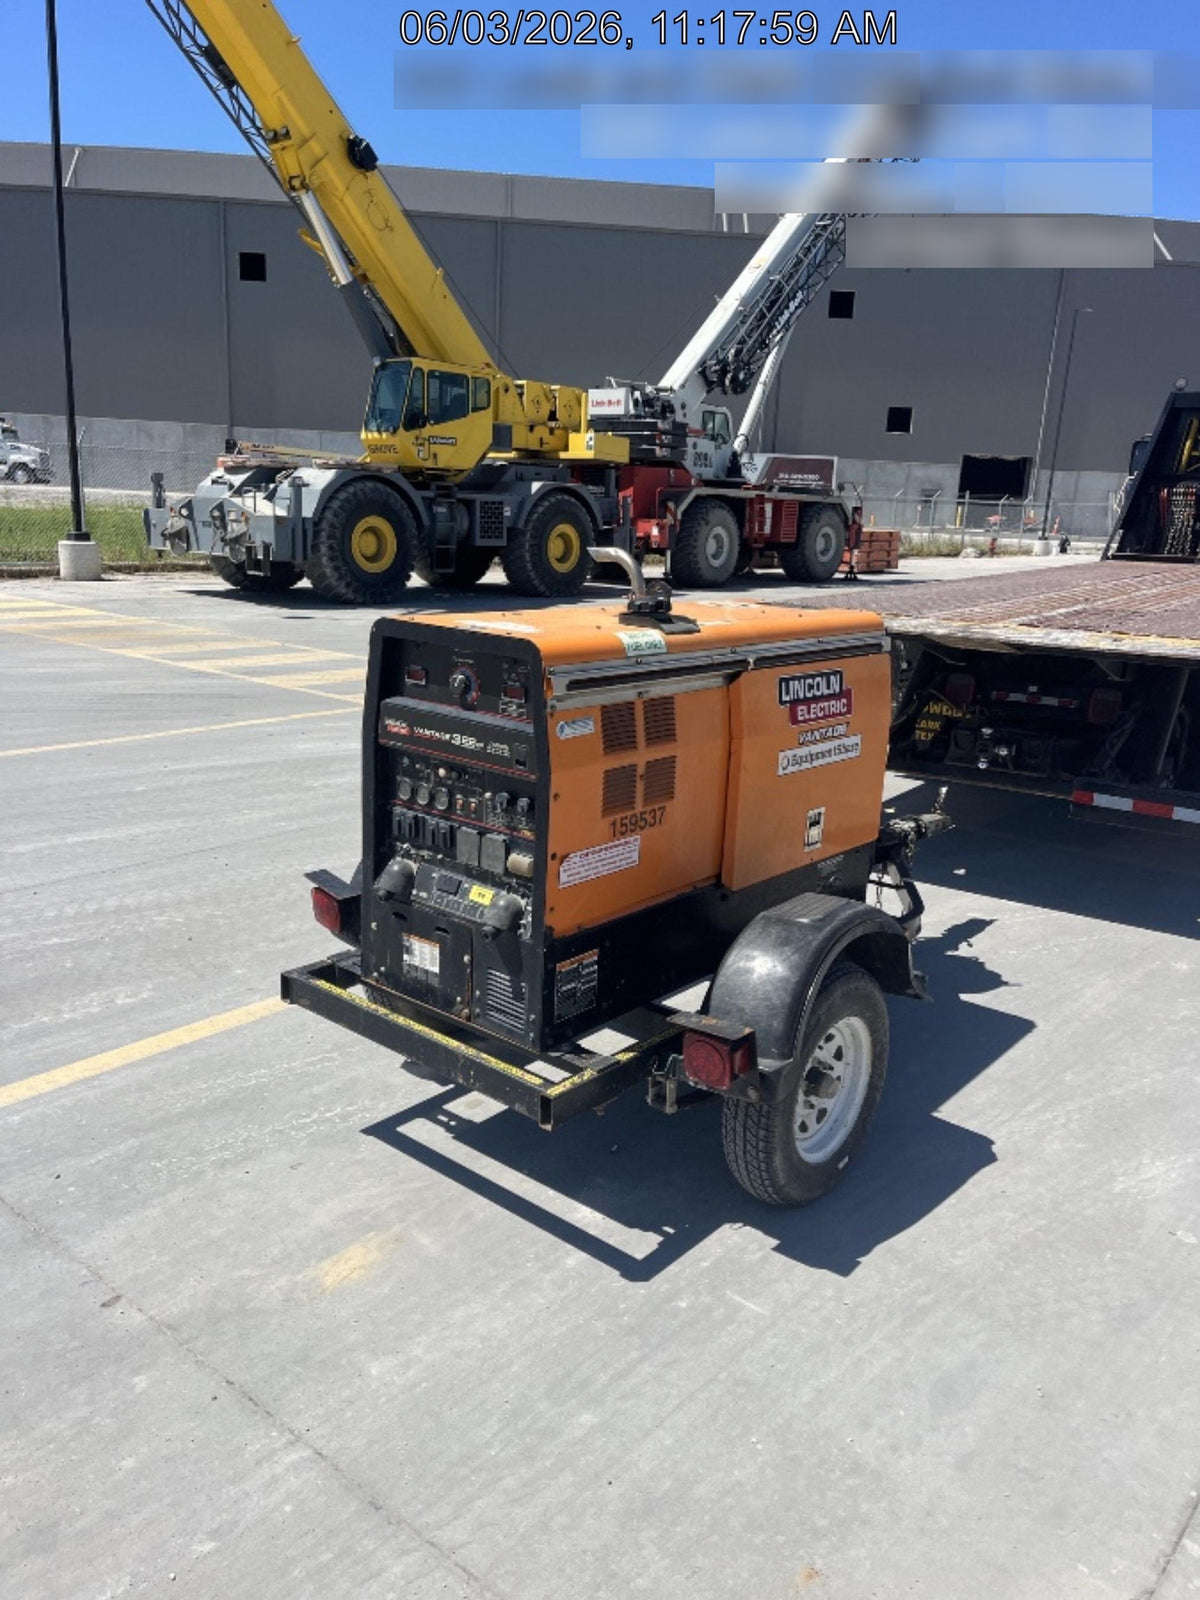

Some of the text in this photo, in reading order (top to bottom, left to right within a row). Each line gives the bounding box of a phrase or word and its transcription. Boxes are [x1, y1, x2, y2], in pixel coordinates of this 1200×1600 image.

[781, 673, 841, 702] LINCOLN
[797, 698, 848, 721] ELECTRIC
[610, 804, 666, 838] 159537
